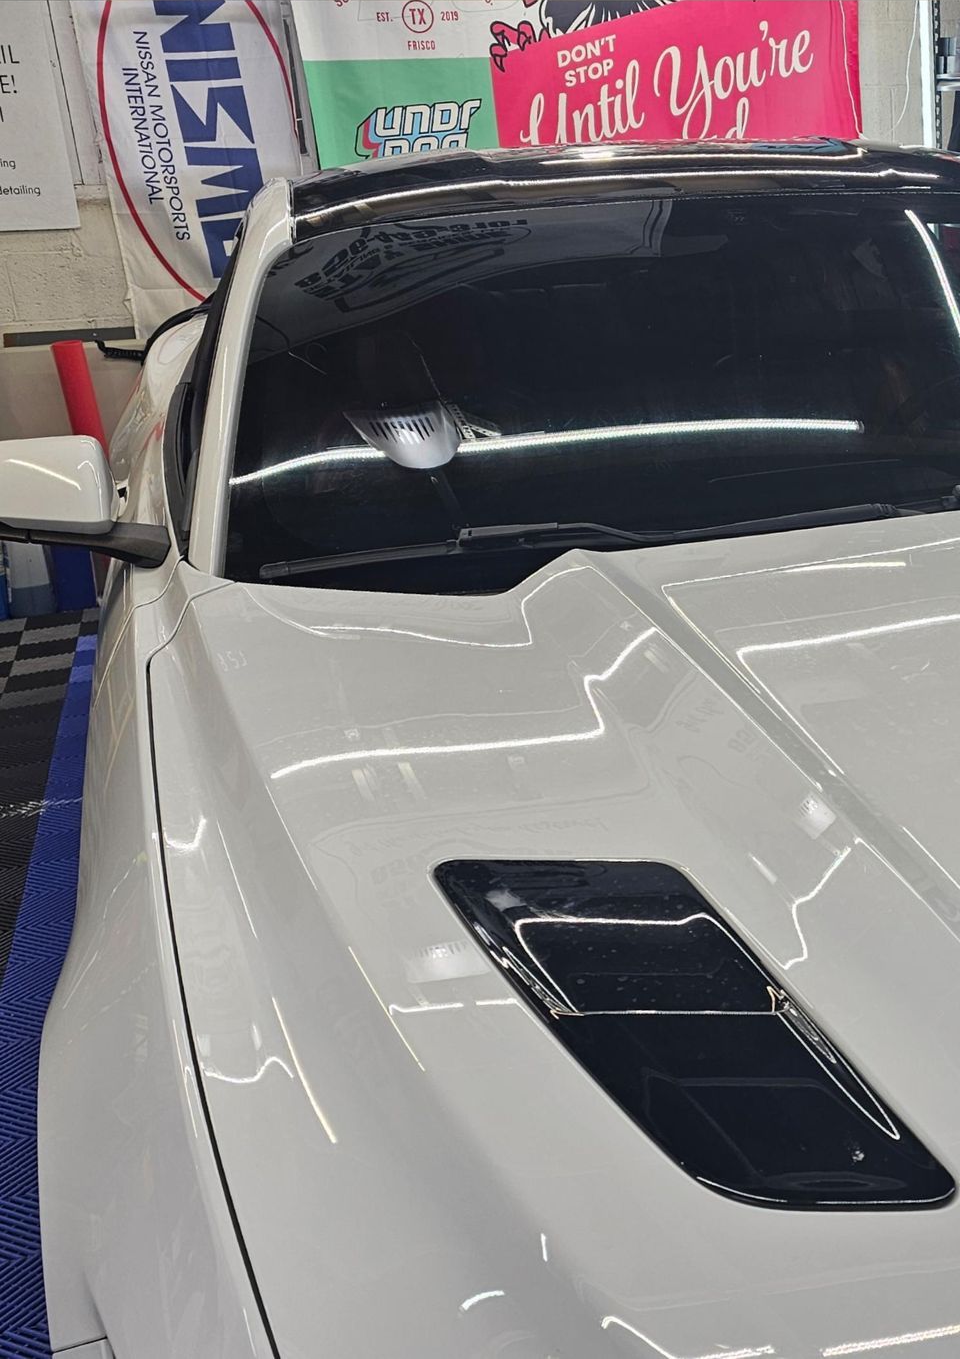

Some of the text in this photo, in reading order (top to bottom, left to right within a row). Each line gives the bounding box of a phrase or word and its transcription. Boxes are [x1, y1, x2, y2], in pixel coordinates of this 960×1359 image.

[376, 8, 459, 25] EST. TX 2019
[407, 40, 436, 50] FRISCO
[557, 34, 617, 68] DON'T
[520, 59, 645, 146] Until
[654, 20, 814, 140] You're
[564, 58, 614, 88] STOP
[122, 67, 164, 205] INTERNATIONAL
[133, 31, 191, 241] NISSAN MOTORSPORTS
